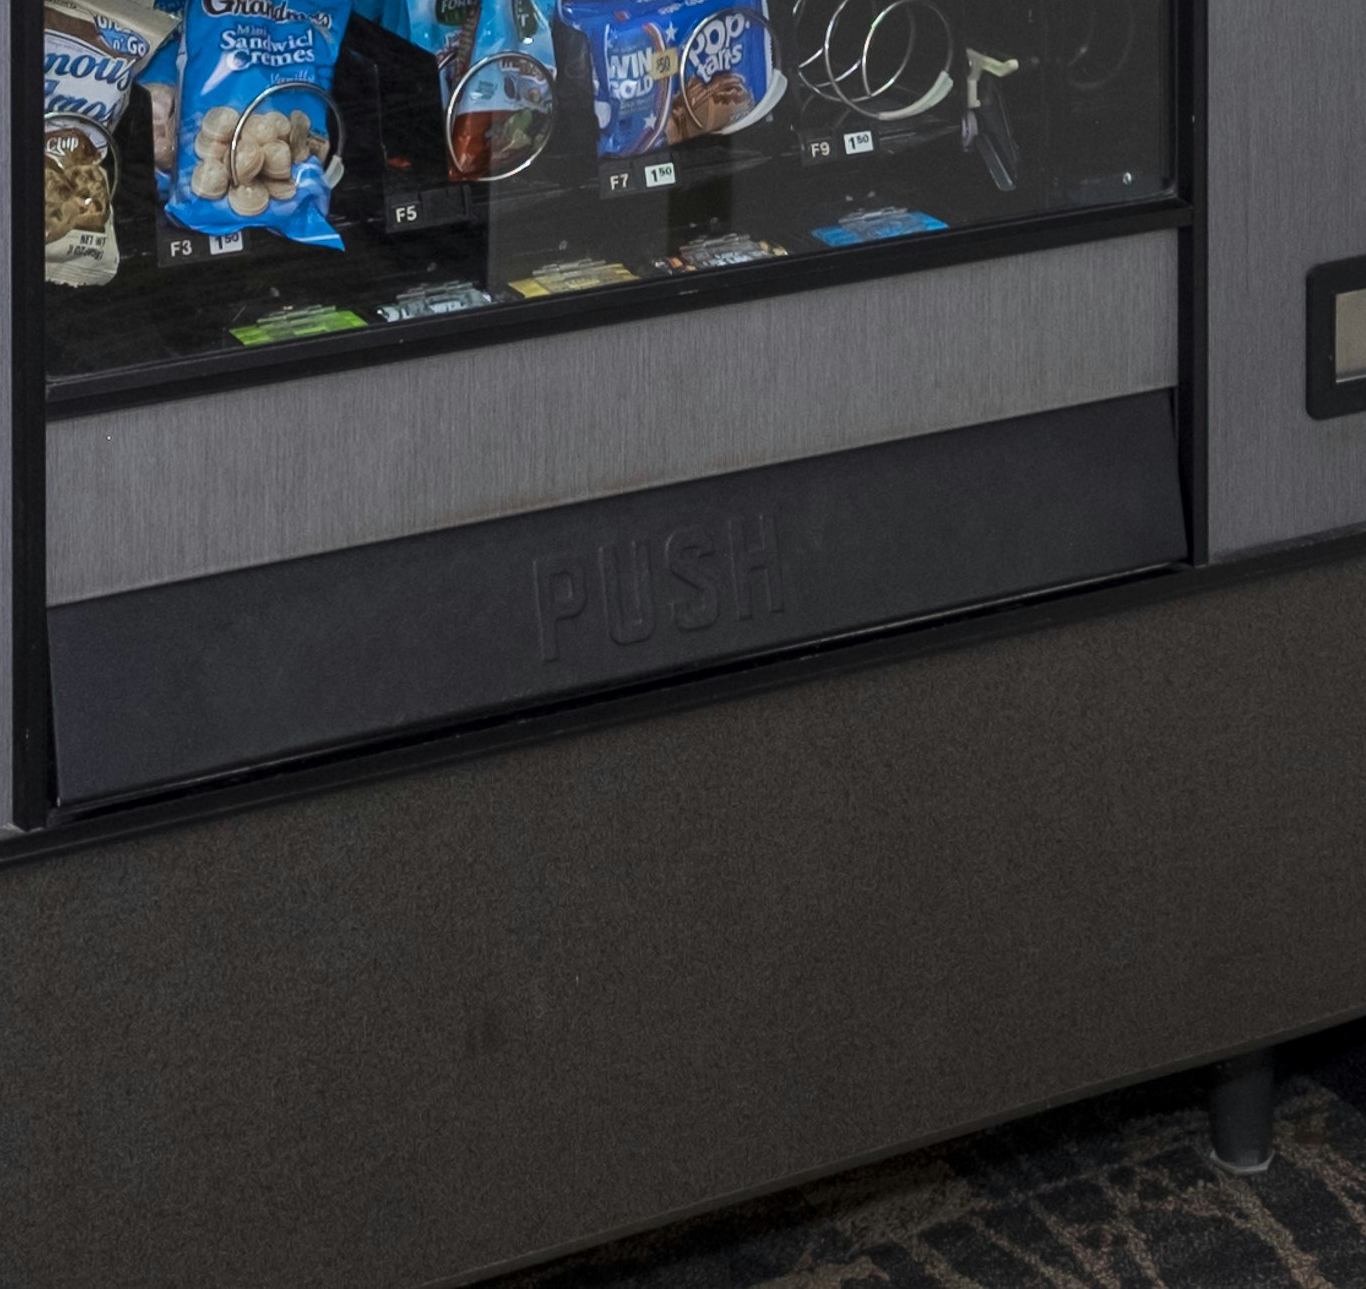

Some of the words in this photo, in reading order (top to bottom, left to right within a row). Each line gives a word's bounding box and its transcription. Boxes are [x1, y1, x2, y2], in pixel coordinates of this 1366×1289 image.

[127, 36, 147, 57] Go
[226, 48, 315, 71] Cremes
[609, 47, 653, 80] WIN
[609, 76, 654, 100] GOLD
[46, 136, 79, 153] Chip
[811, 141, 830, 157] F9
[610, 174, 629, 191] F7
[395, 206, 418, 221] F5
[171, 240, 193, 257] F3
[533, 513, 785, 664] PUSH
